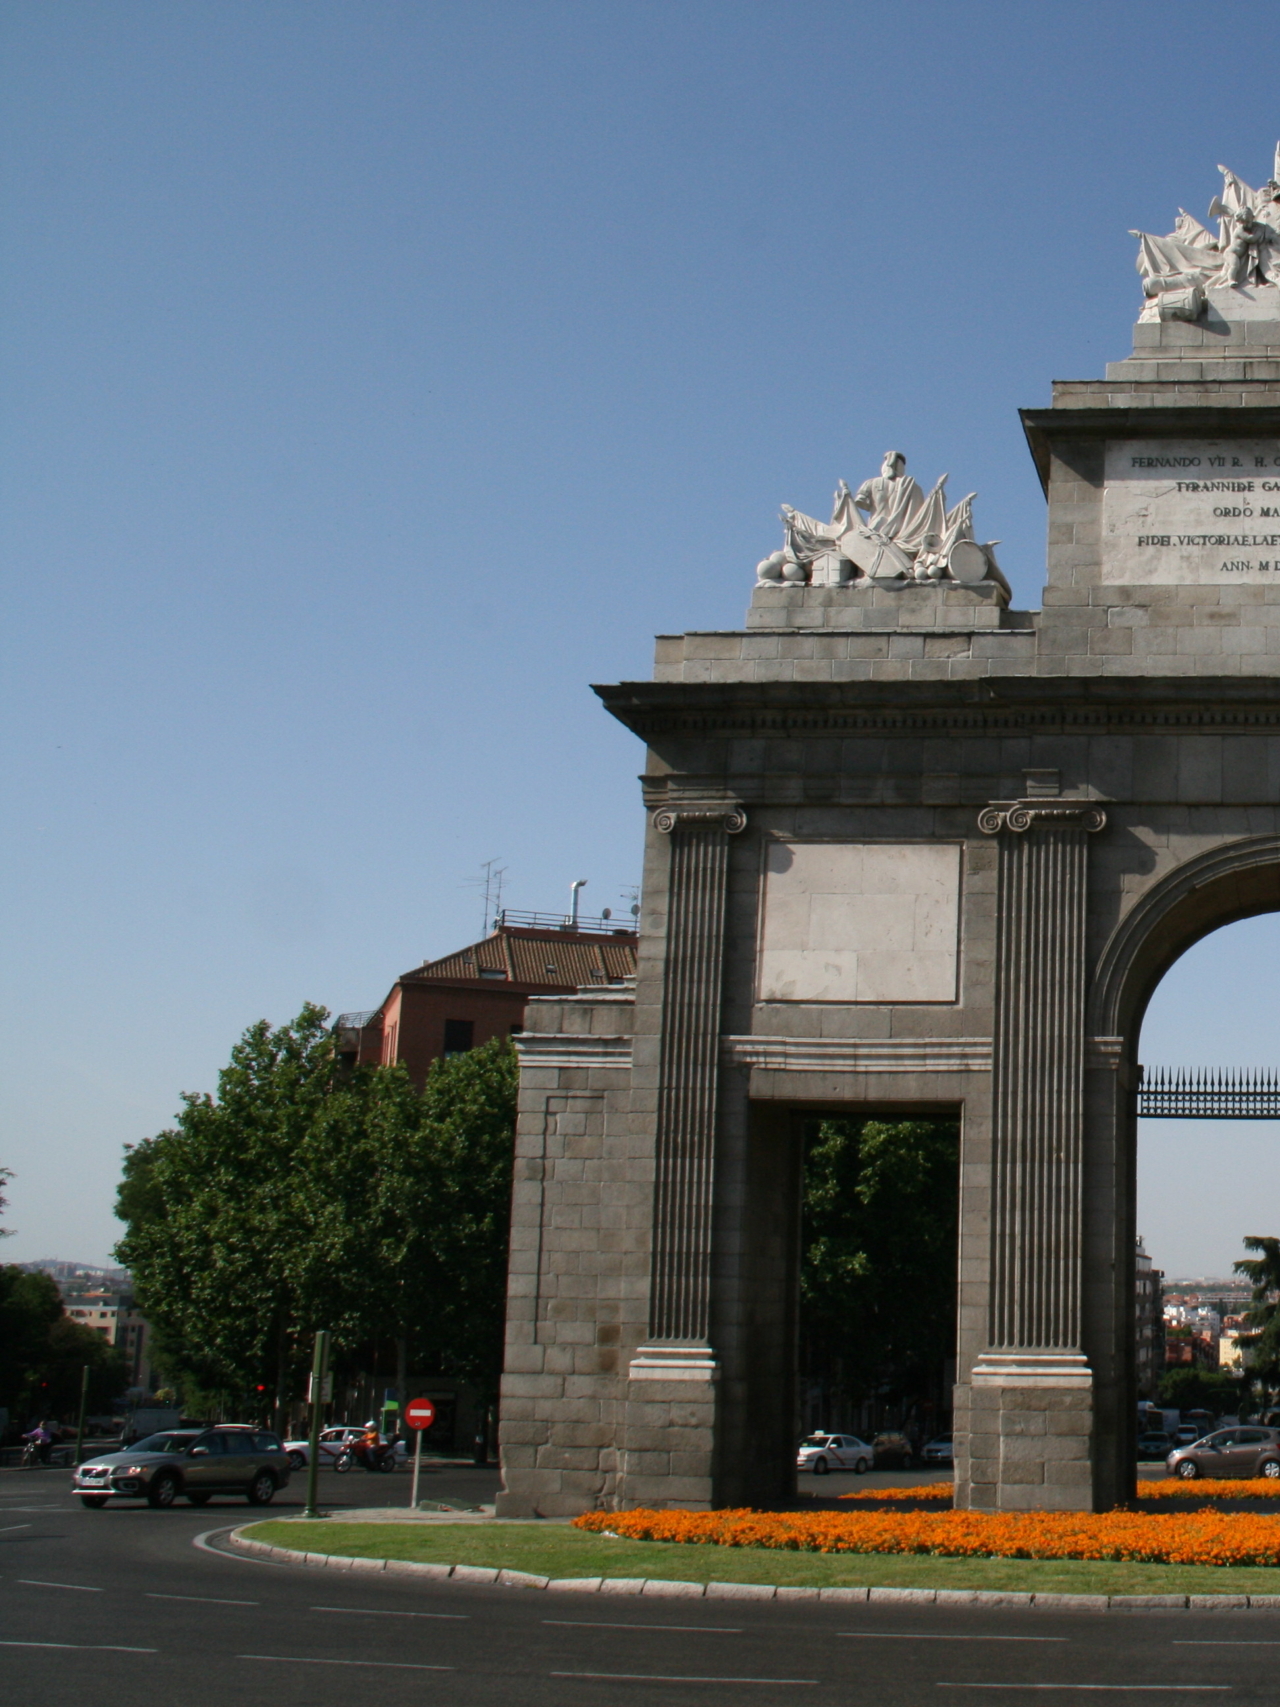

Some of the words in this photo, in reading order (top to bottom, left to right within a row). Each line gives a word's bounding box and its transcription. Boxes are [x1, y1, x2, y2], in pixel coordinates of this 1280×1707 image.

[1131, 457, 1201, 467] FERNANDO
[1208, 455, 1225, 467] VII
[1232, 457, 1243, 467] R.
[1254, 457, 1267, 467] H.
[1176, 481, 1255, 492] TYRANNIDE
[1213, 507, 1253, 517] ORDO
